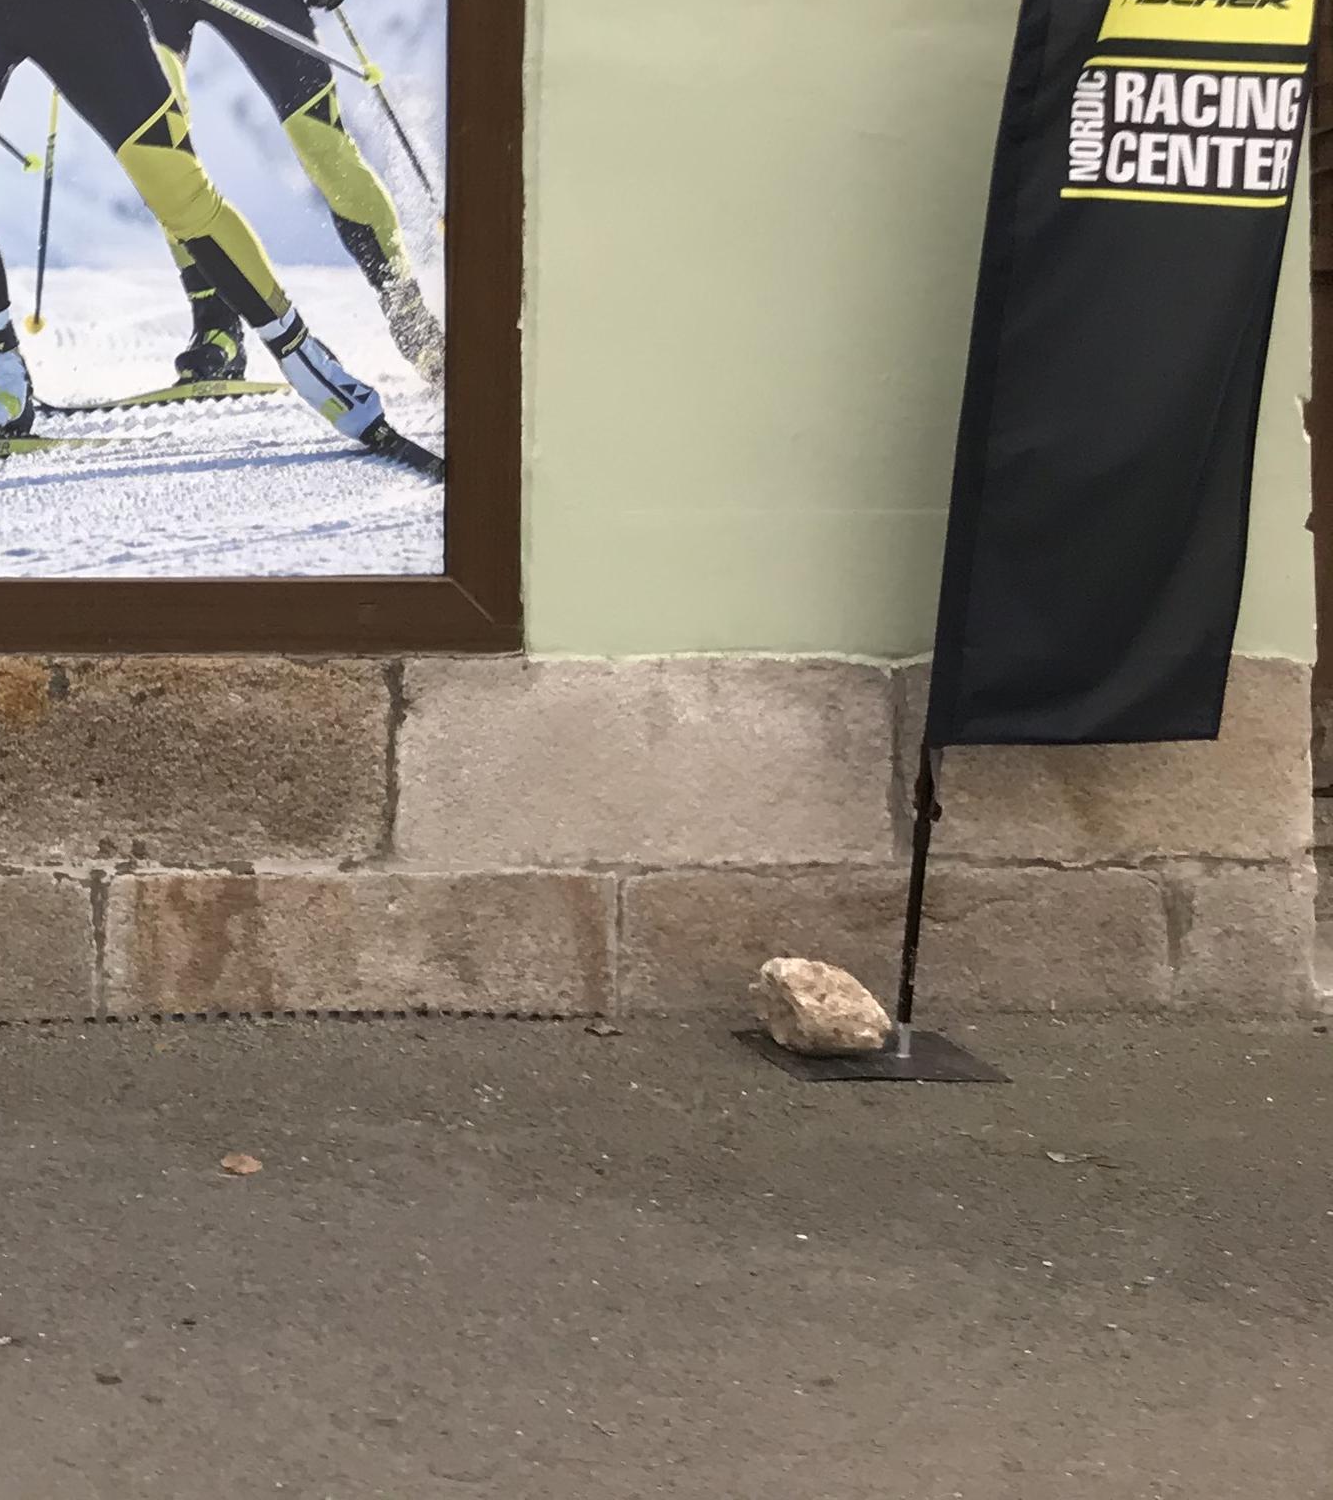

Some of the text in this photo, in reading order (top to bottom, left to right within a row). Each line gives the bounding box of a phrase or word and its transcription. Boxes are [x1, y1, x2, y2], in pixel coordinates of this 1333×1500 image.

[1069, 69, 1109, 183] NORDIC
[1114, 71, 1303, 132] RACING
[1105, 130, 1293, 191] CENTER
